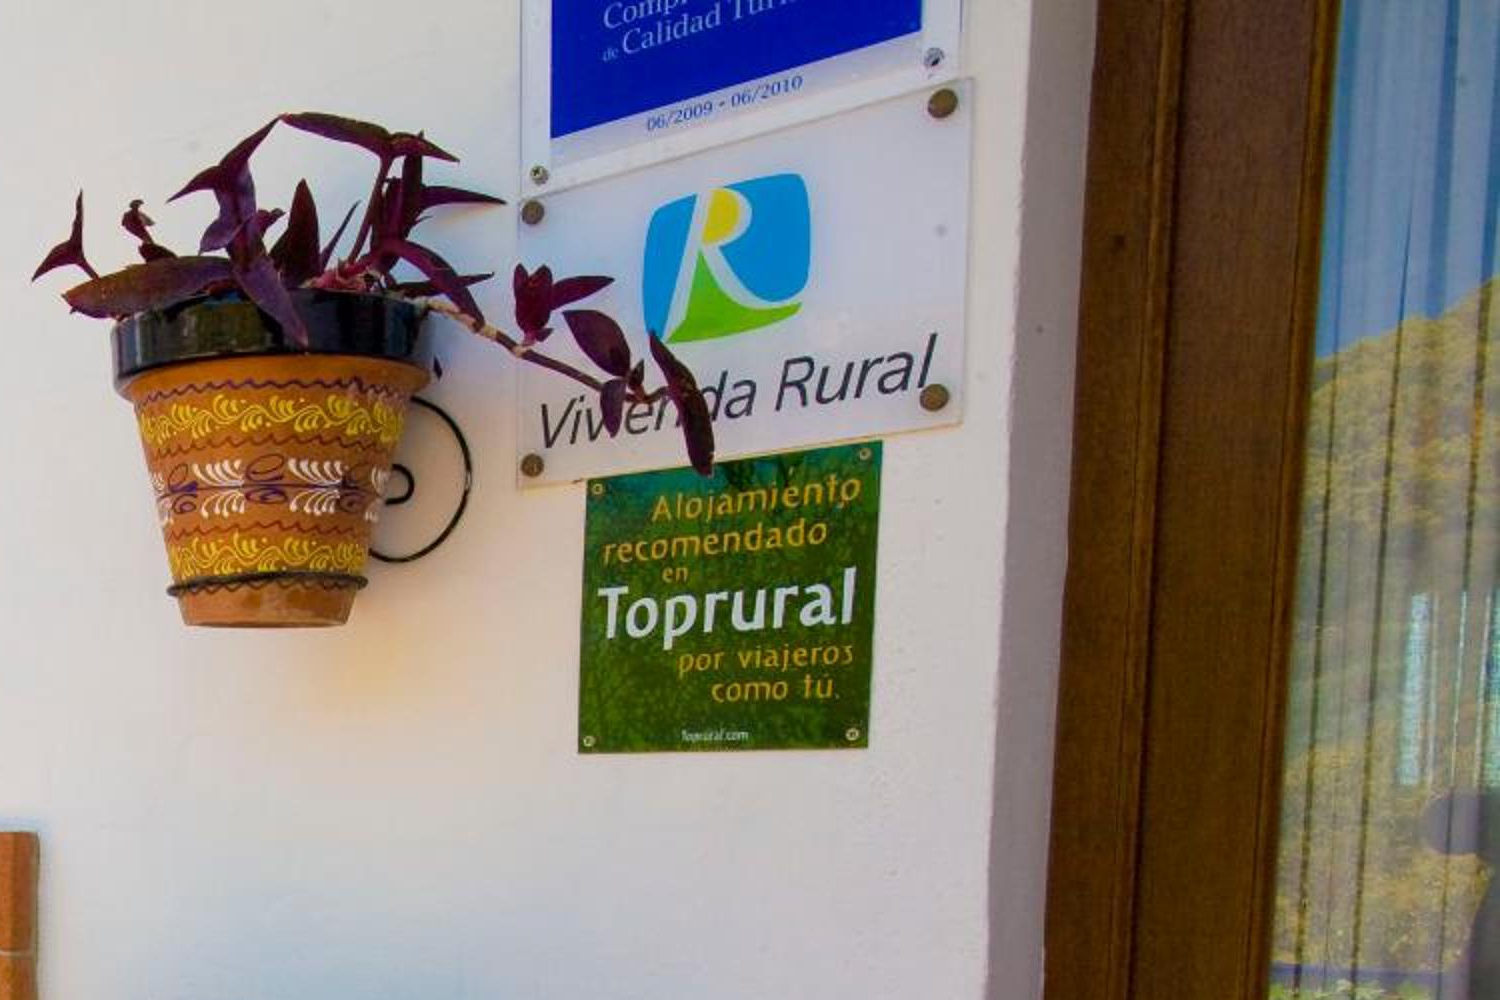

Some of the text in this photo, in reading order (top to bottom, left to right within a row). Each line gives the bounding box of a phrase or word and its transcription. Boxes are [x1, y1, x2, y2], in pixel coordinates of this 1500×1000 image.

[602, 0, 688, 29] Comp
[622, 13, 721, 55] Calidad
[646, 100, 713, 131] 06/2009
[730, 75, 804, 108] 06/2010
[775, 332, 938, 411] Rural
[651, 474, 862, 523] Alojamiento
[603, 518, 828, 566] recomendado
[662, 566, 689, 583] en
[597, 566, 857, 650] Toprural
[677, 644, 854, 678] por viajeros
[711, 681, 789, 703] como
